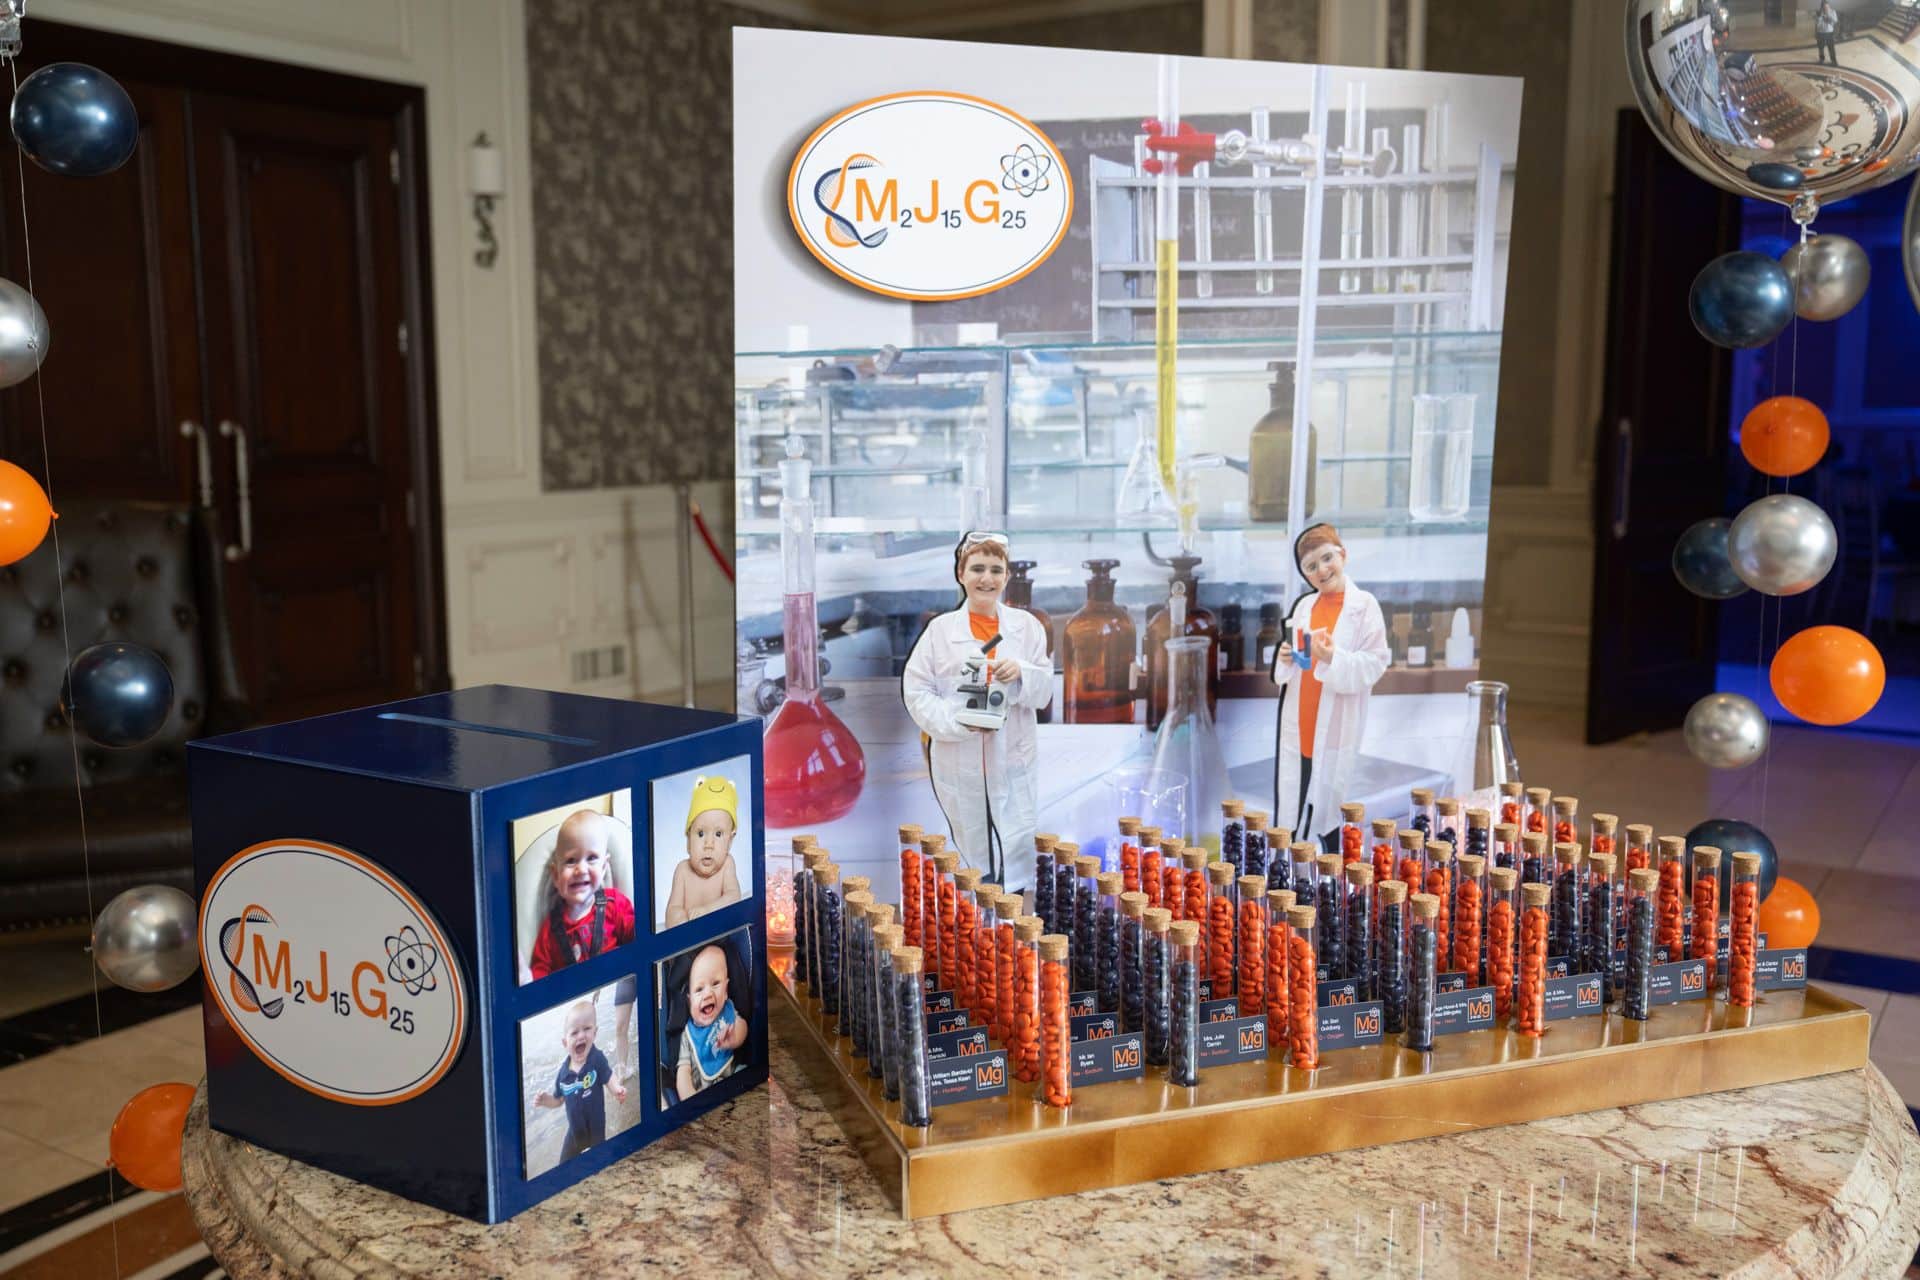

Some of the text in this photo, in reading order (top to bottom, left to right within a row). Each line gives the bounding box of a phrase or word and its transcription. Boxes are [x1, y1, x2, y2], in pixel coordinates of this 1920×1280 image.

[1784, 960, 1803, 978] Mg
[1682, 973, 1702, 989] Mg
[1579, 987, 1598, 1004] Mg
[1469, 1001, 1490, 1018] Mg
[1356, 1016, 1378, 1033] Mg
[1241, 1031, 1263, 1048] Mg
[1115, 1048, 1138, 1066] Mg
[977, 1066, 1002, 1084] Mg
